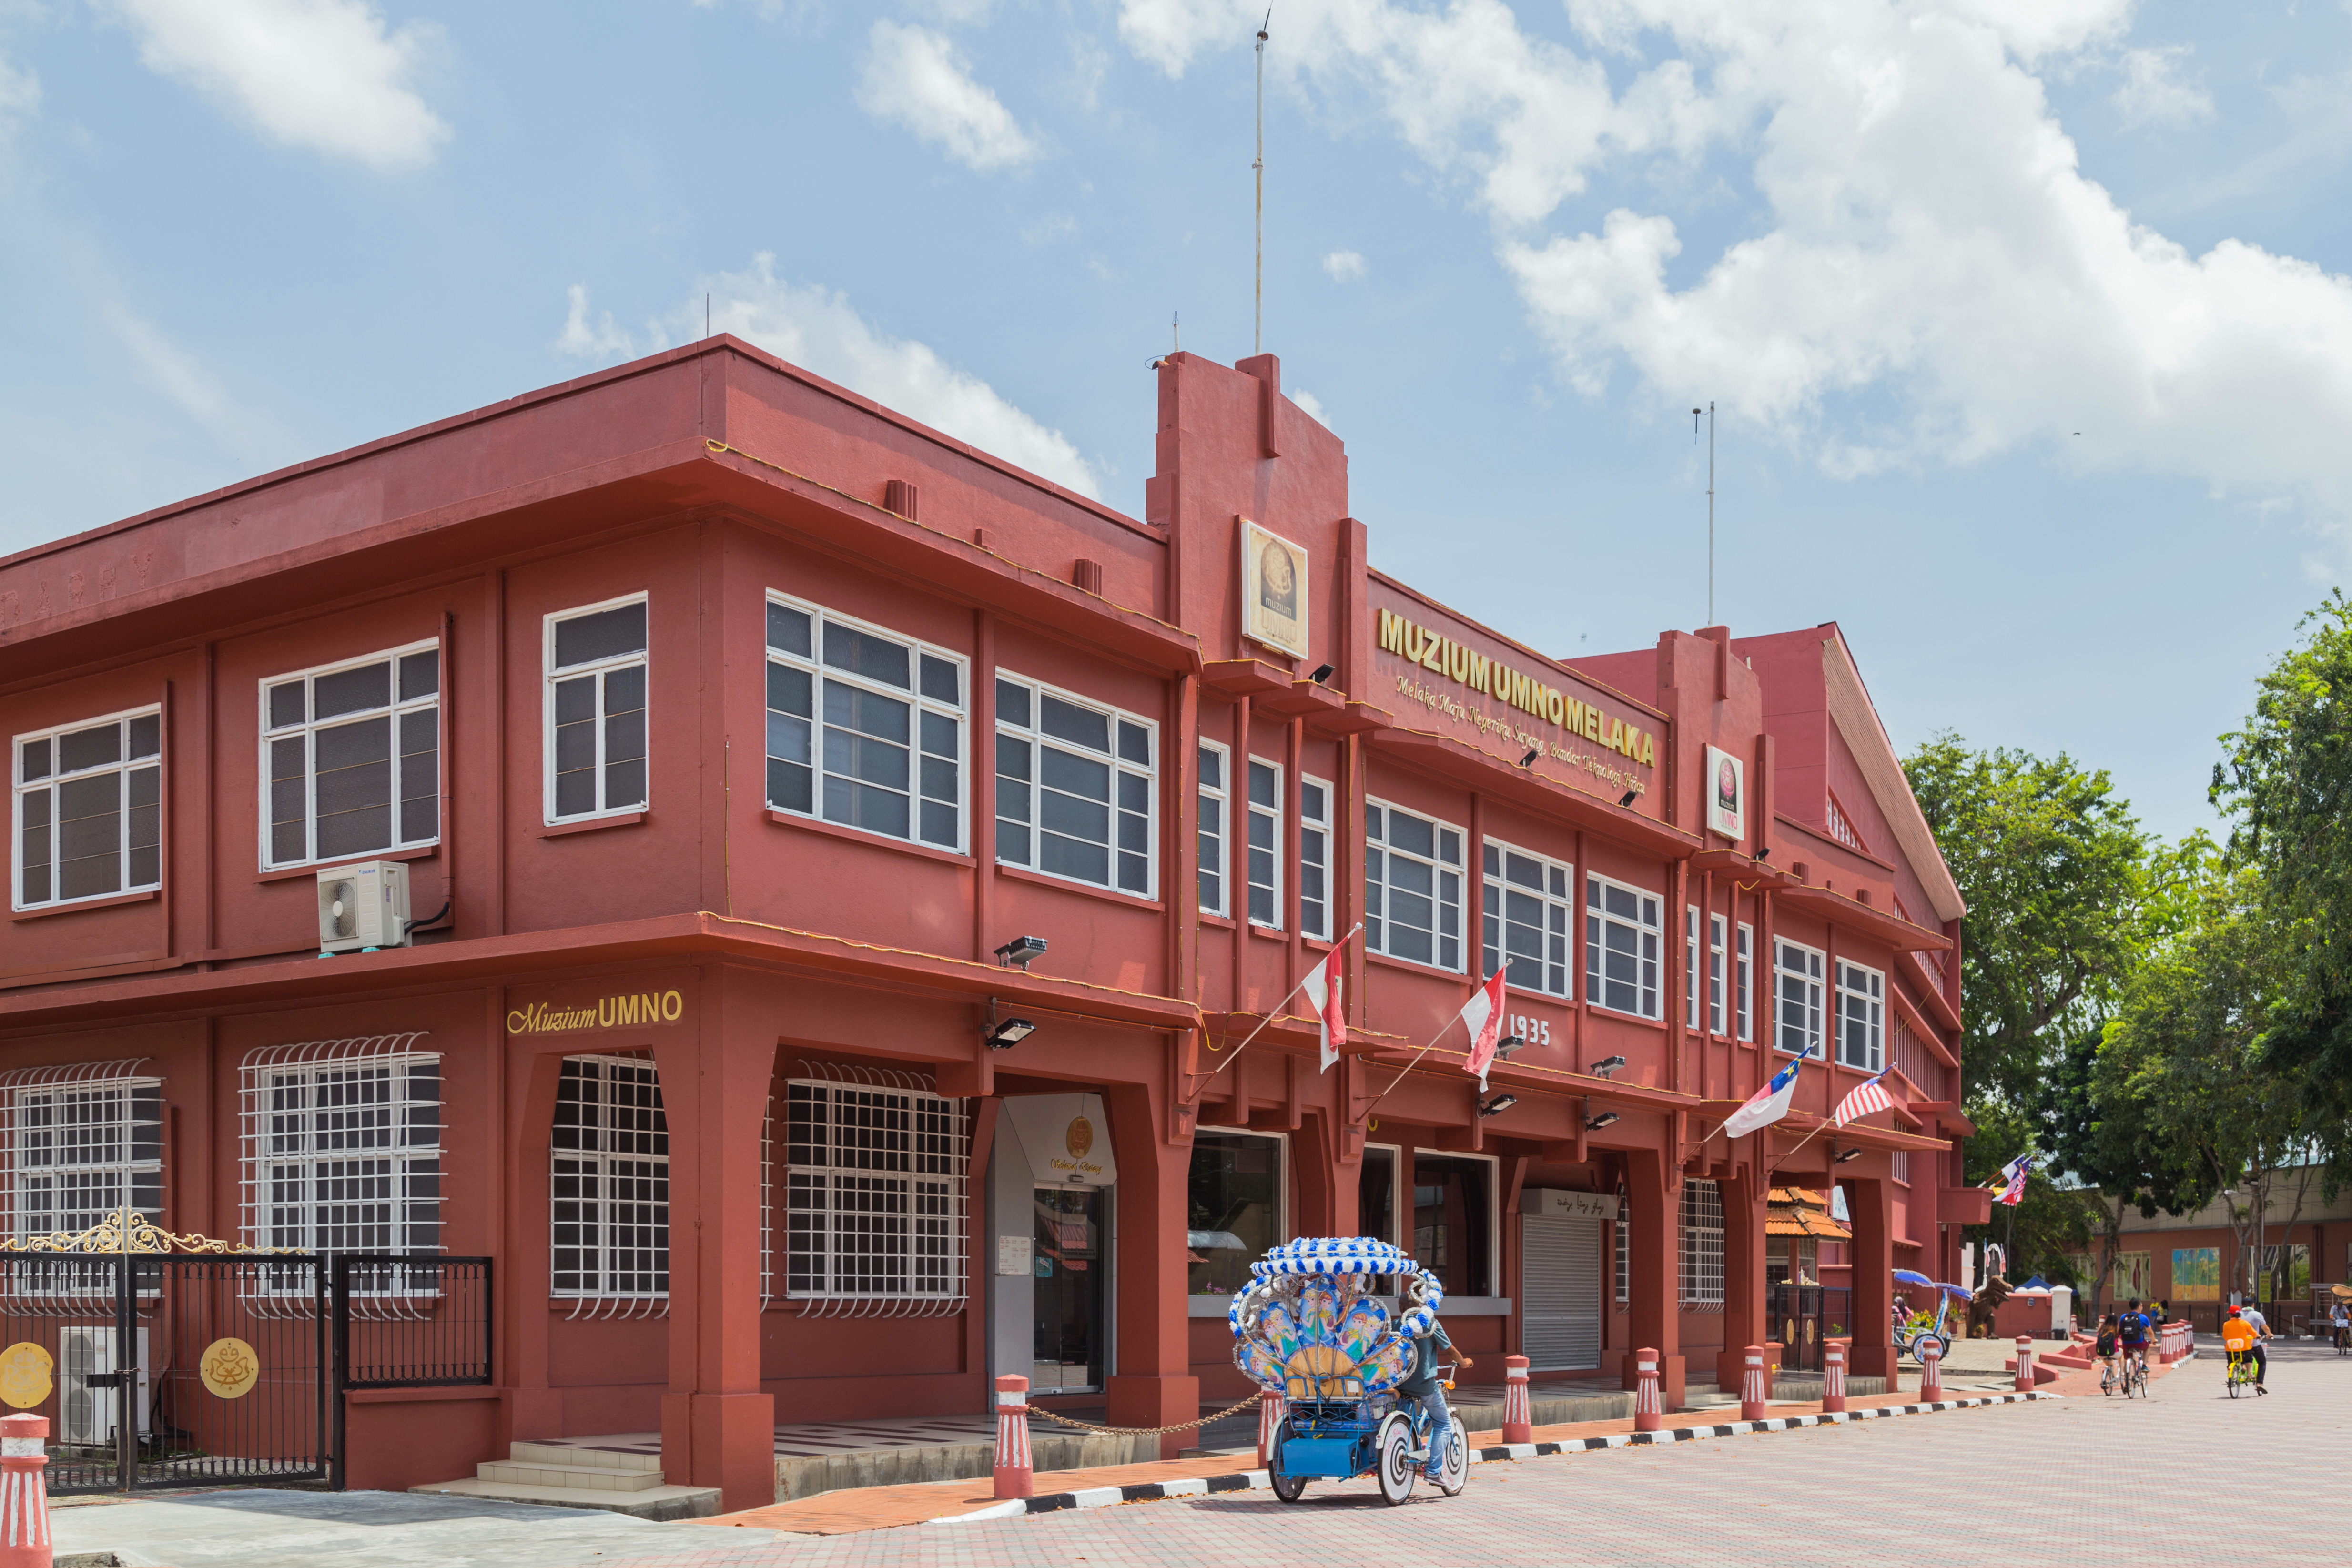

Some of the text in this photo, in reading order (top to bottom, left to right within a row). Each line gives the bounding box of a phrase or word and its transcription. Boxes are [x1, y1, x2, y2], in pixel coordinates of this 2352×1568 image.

[1266, 597, 1291, 617] MUZIUM
[1261, 608, 1297, 642] UMNO
[1379, 608, 1655, 768] MUZIUM UMNO MELAKA
[1397, 676, 1645, 795] Melaka Maju Negeriku Sayang, Bandar Teknologi Hijau
[1719, 808, 1738, 830] UMNO
[1721, 799, 1735, 811] MUZIUM
[507, 990, 682, 1034] Muzium UMNO
[1510, 1014, 1550, 1045] 1935
[1051, 1158, 1103, 1176] Selamat Datang
